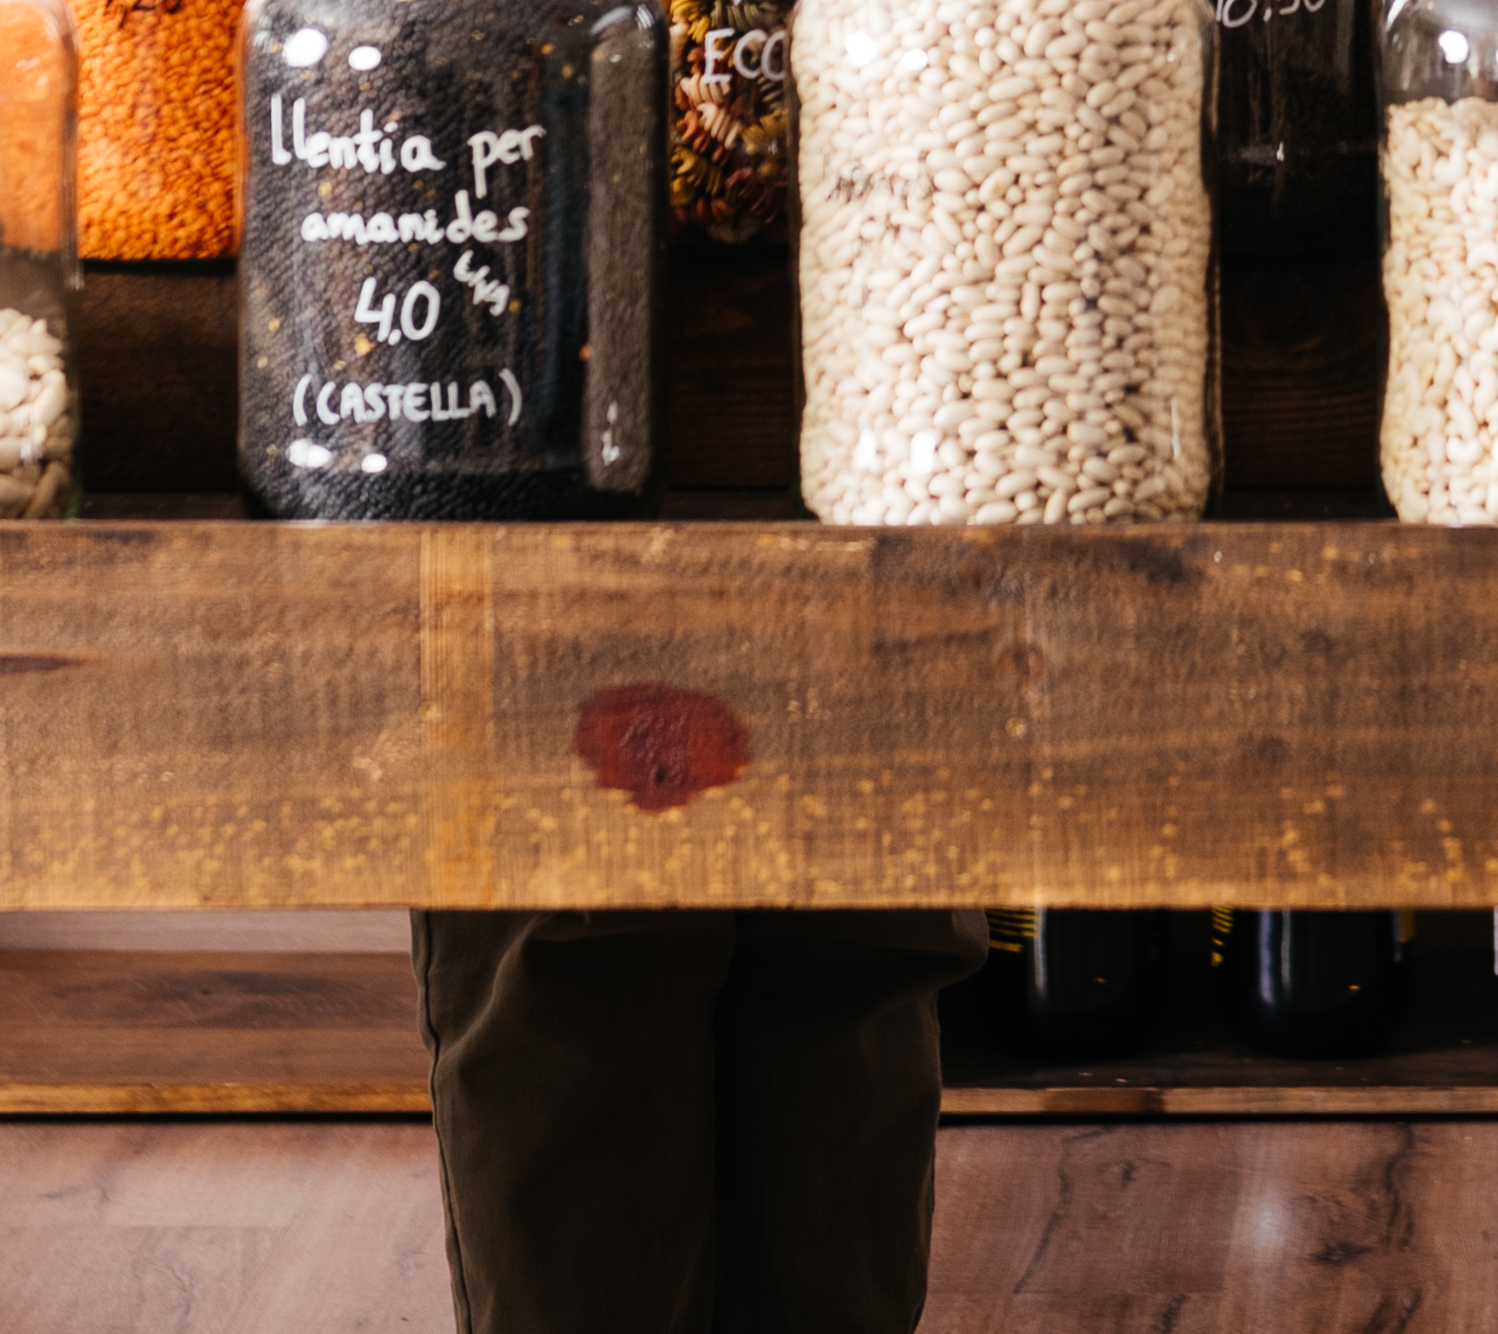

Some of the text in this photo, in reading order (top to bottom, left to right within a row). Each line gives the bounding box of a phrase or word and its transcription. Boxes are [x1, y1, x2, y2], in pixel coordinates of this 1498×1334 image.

[468, 122, 546, 200] per
[301, 189, 529, 245] amanides
[292, 367, 523, 428] (CASTELLA)
